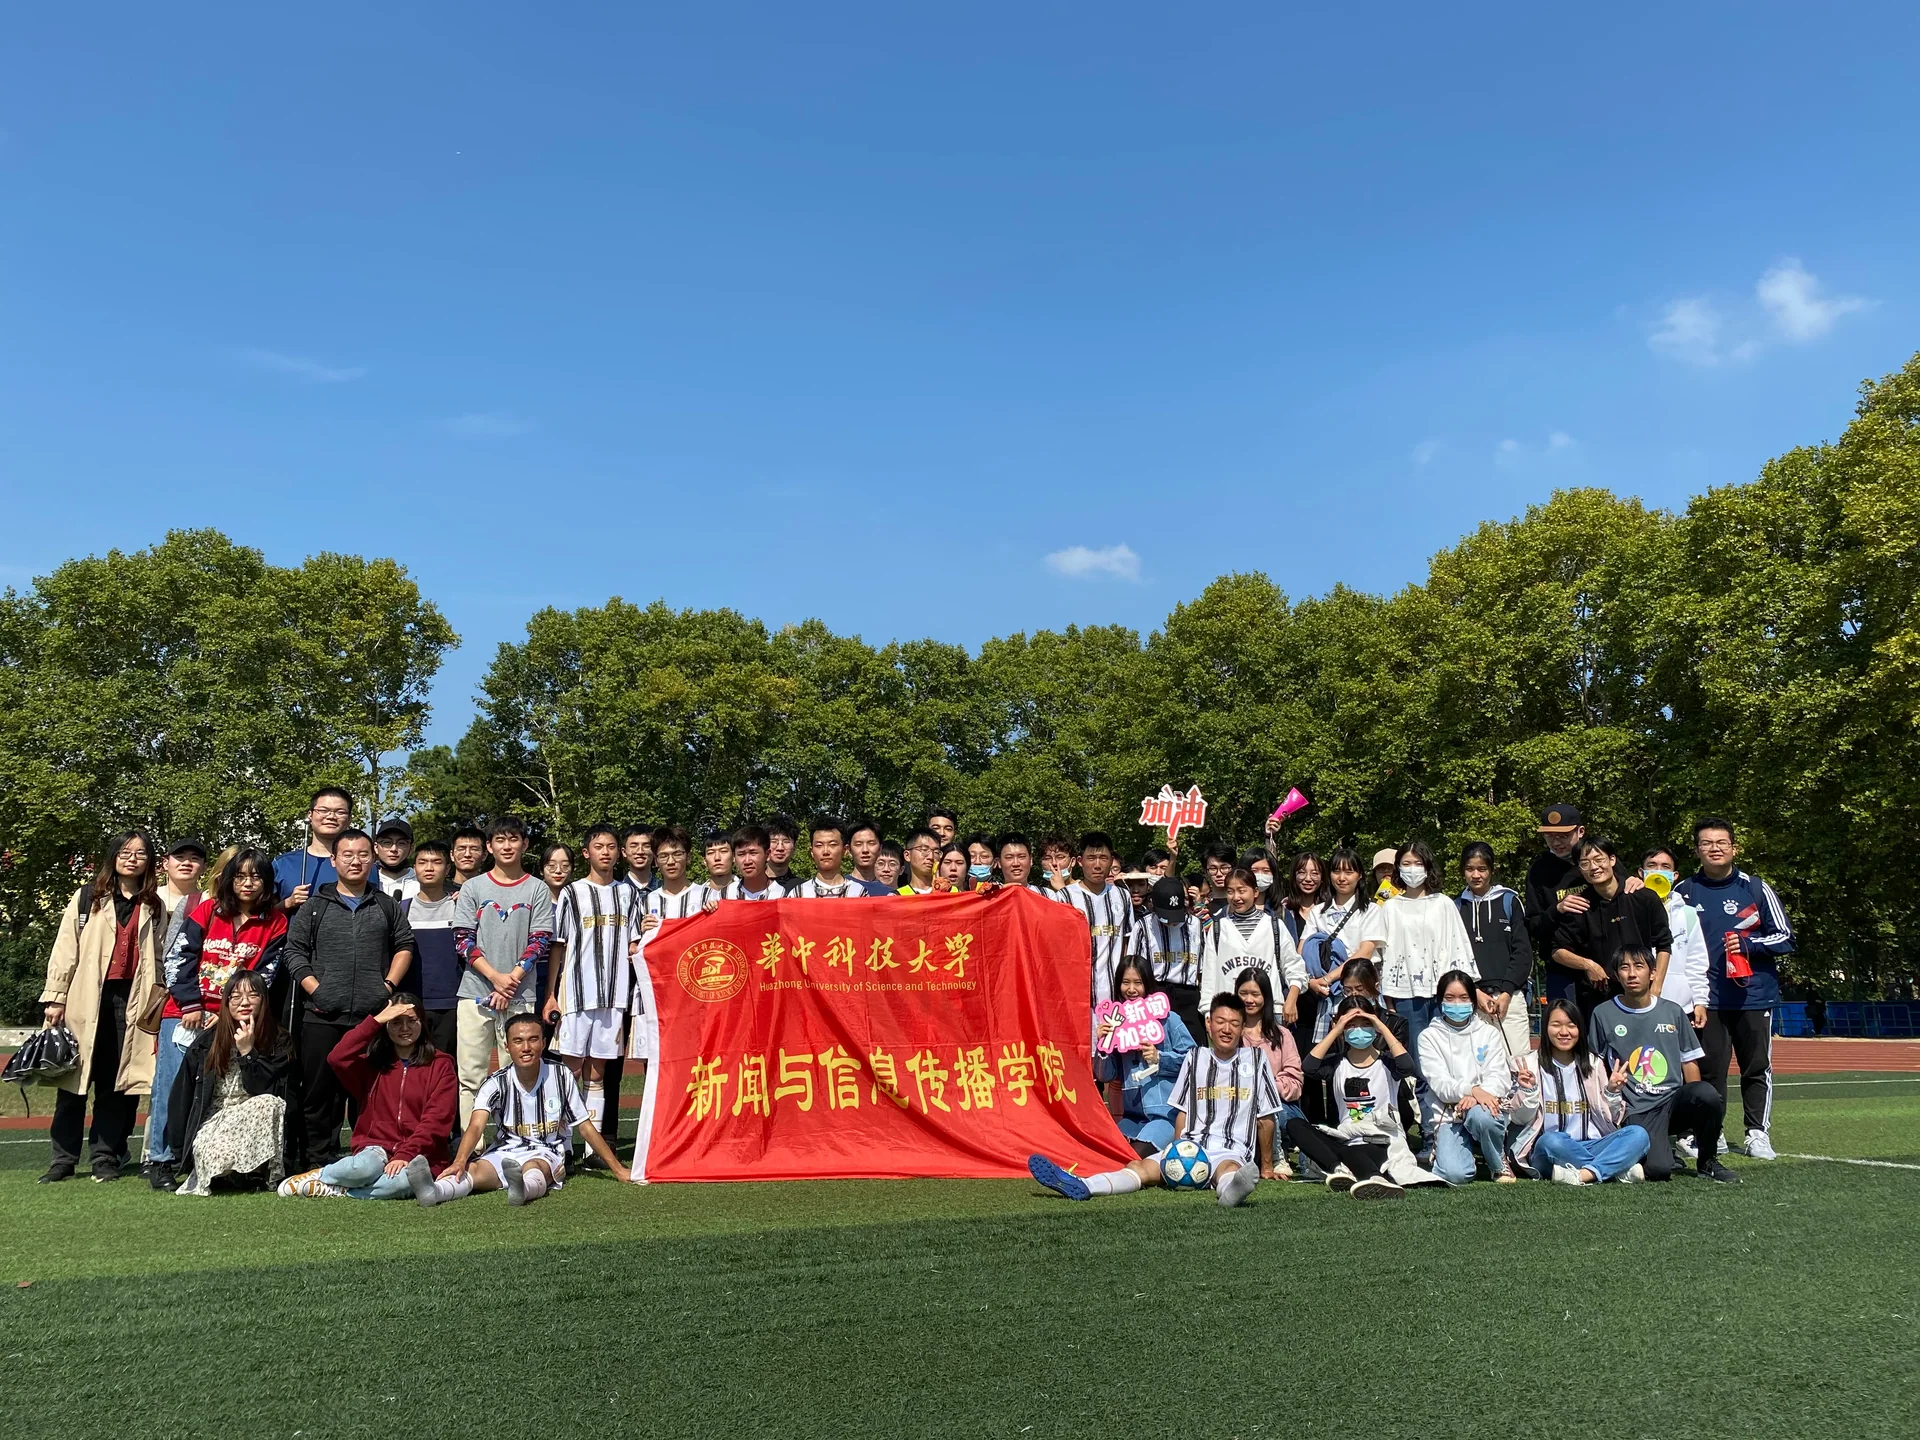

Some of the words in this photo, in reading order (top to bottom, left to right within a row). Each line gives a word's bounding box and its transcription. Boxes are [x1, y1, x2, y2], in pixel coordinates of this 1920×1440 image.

[1141, 788, 1206, 836] 加油
[1221, 956, 1272, 976] AWESOME
[759, 980, 802, 992] Huazhong
[805, 980, 851, 993] University
[853, 981, 863, 992] of
[865, 981, 902, 992] Science
[905, 981, 923, 991] and
[926, 980, 977, 992] Technology
[1123, 995, 1168, 1023] 新闻
[1116, 1020, 1162, 1049] 加油
[686, 1040, 1077, 1122] 新闻与信息传播学院
[1197, 1086, 1250, 1100] 新闻学院
[1545, 1101, 1588, 1114] 新闻学
